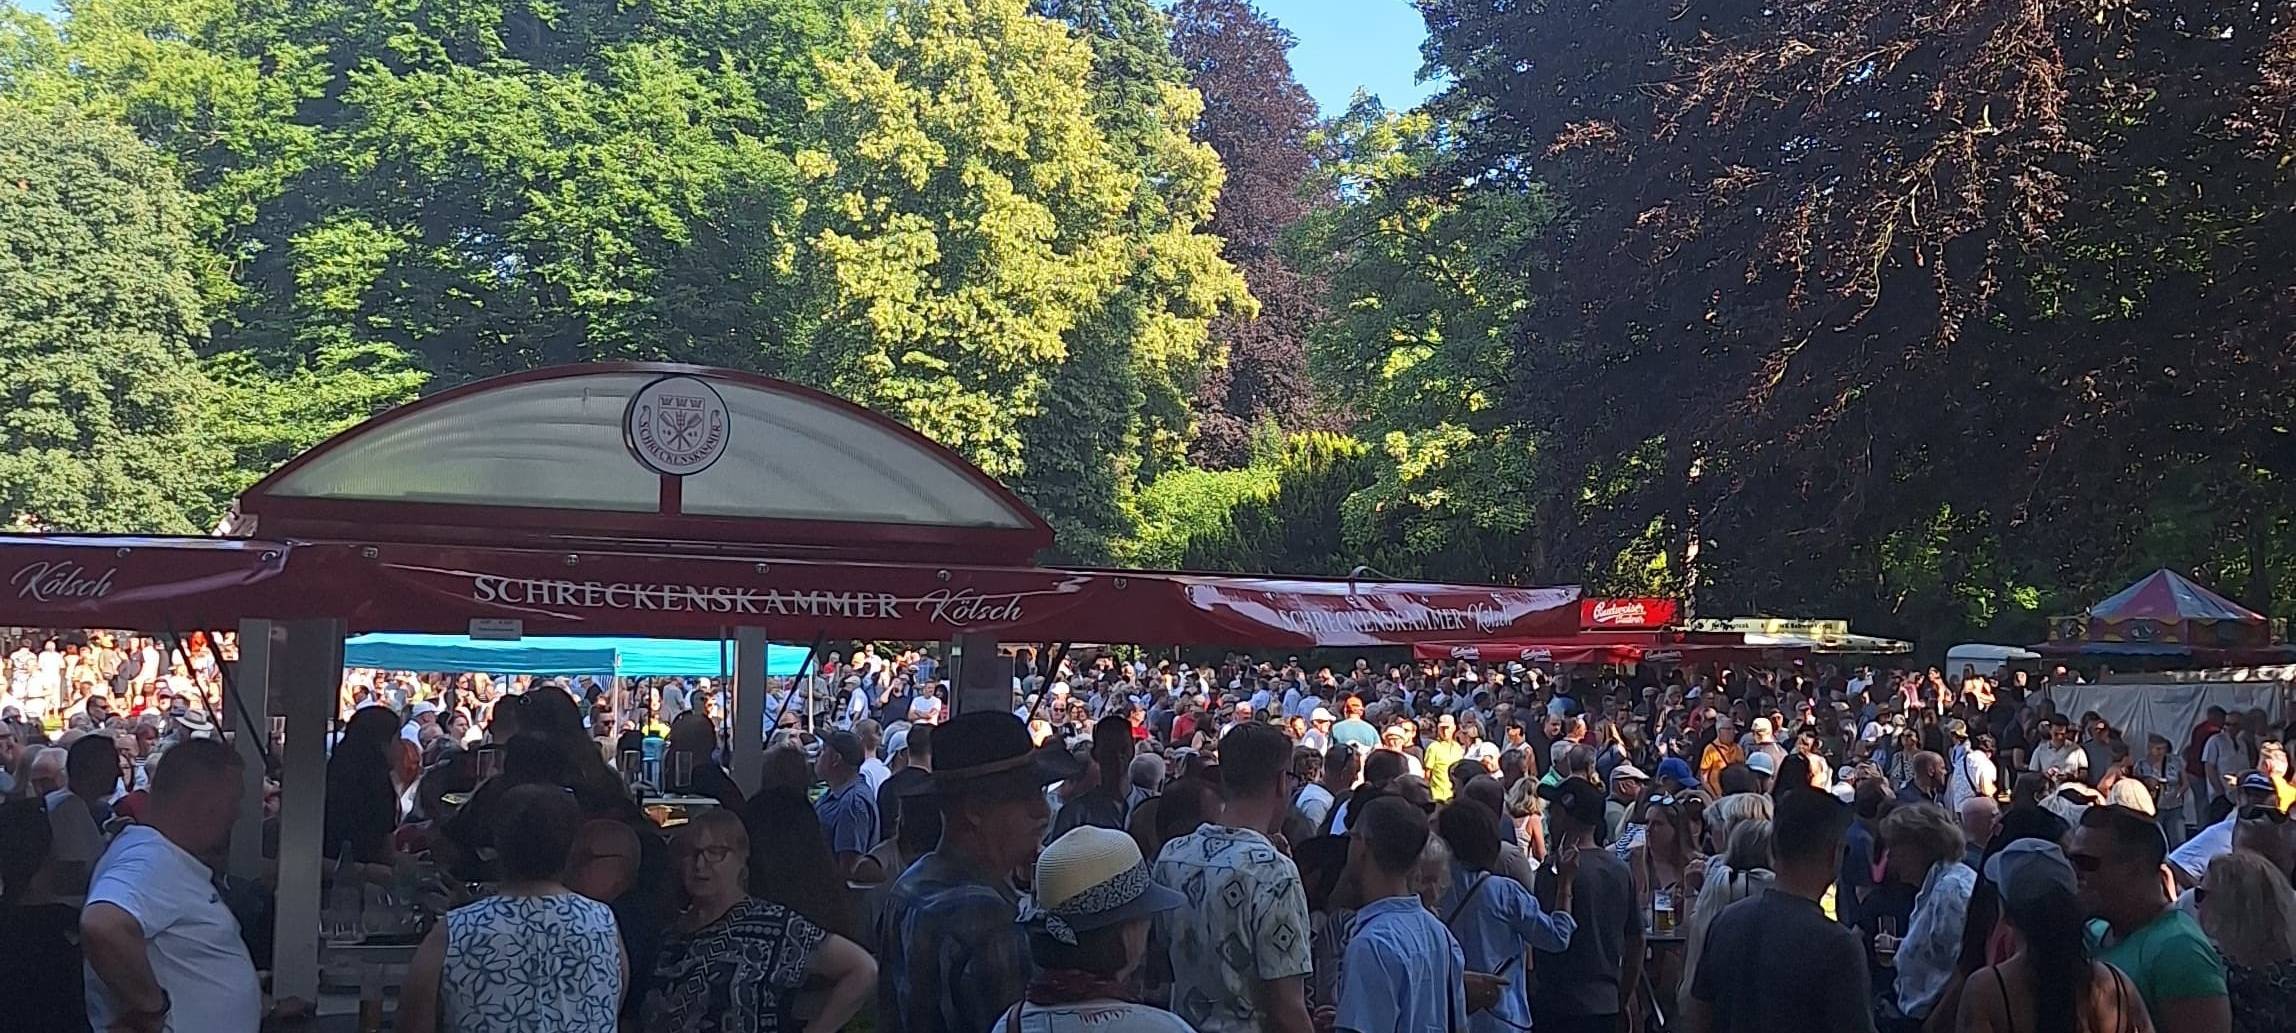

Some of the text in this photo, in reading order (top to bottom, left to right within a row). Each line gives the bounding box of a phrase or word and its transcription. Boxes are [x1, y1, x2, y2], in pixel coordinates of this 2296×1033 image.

[639, 421, 722, 465] SCHRECKENSKAMMER
[10, 560, 118, 602] Kölsch
[473, 575, 1024, 626] SCHRECKENSKAMMER Kölsch
[1279, 607, 1466, 634] SCHRECKENSKAMMER
